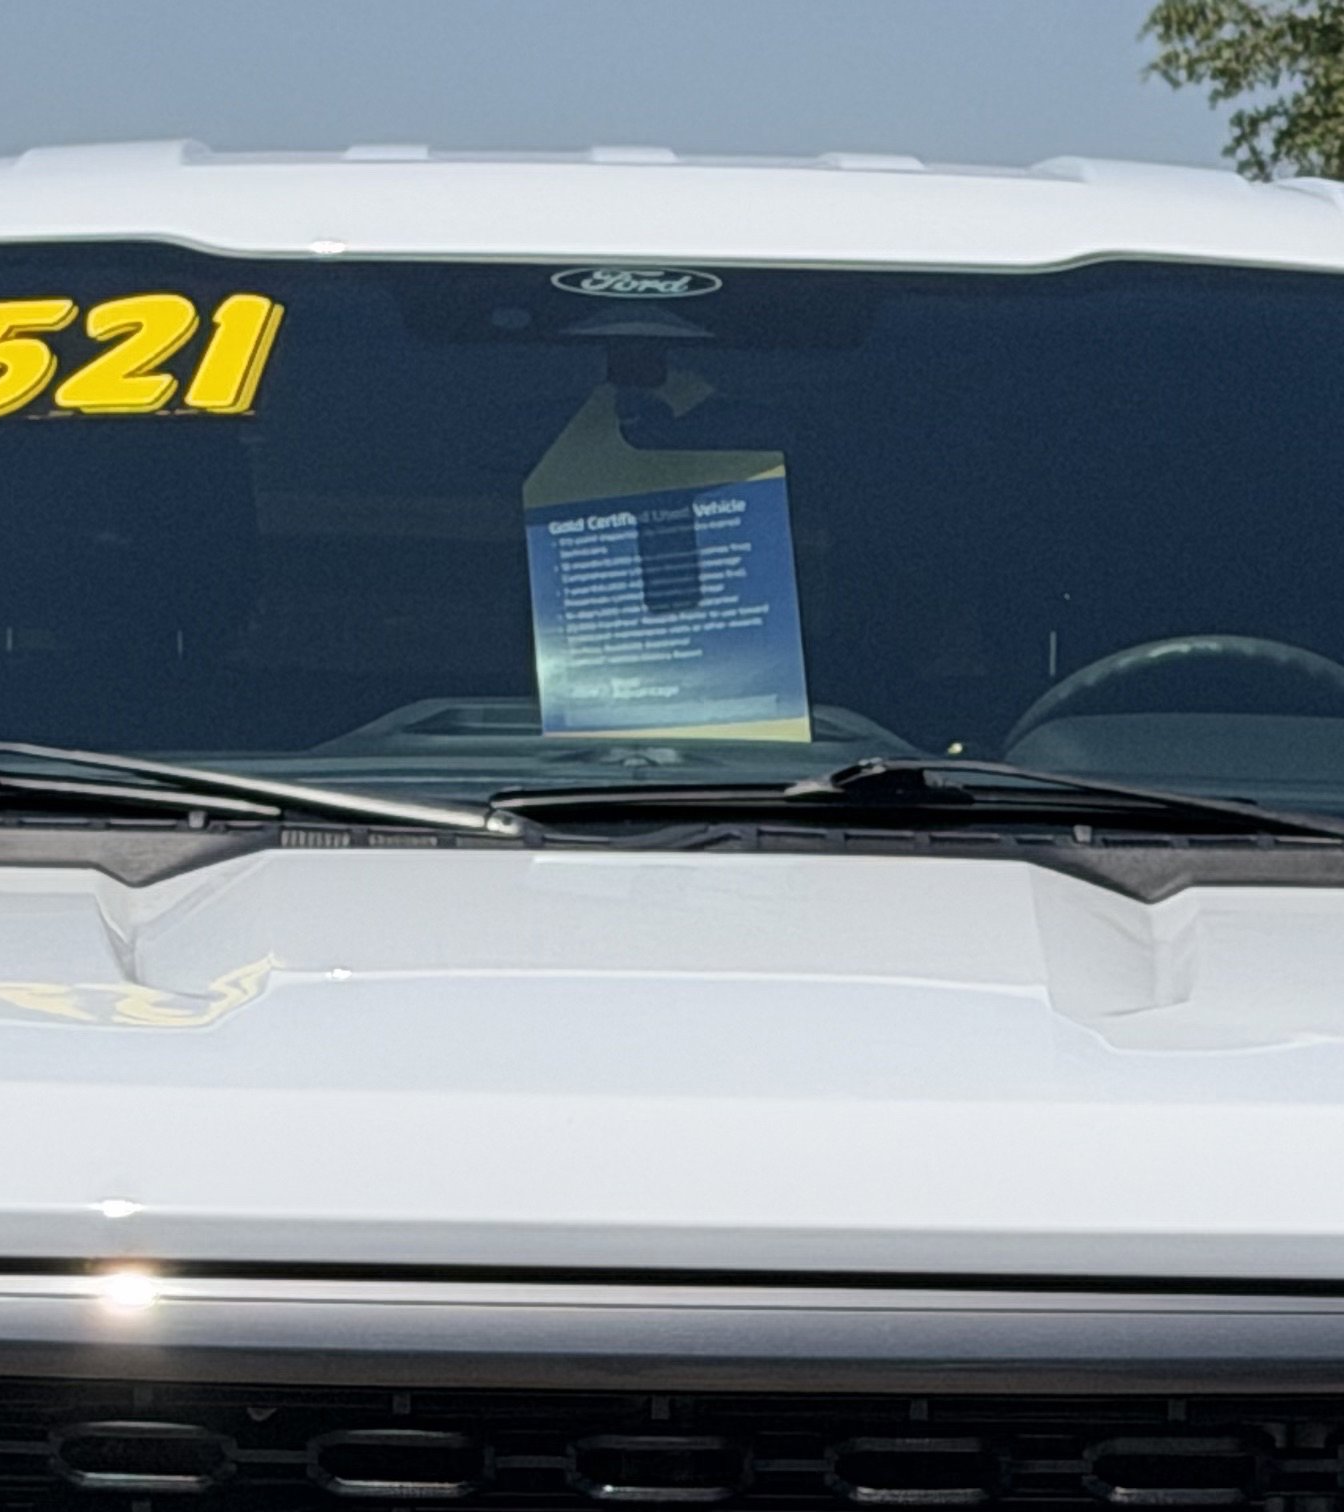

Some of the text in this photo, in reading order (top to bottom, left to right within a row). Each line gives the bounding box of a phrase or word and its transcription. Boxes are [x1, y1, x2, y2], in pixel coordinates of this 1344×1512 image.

[580, 268, 692, 293] Ford
[548, 518, 585, 535] Gold
[693, 499, 747, 517] Vehicle
